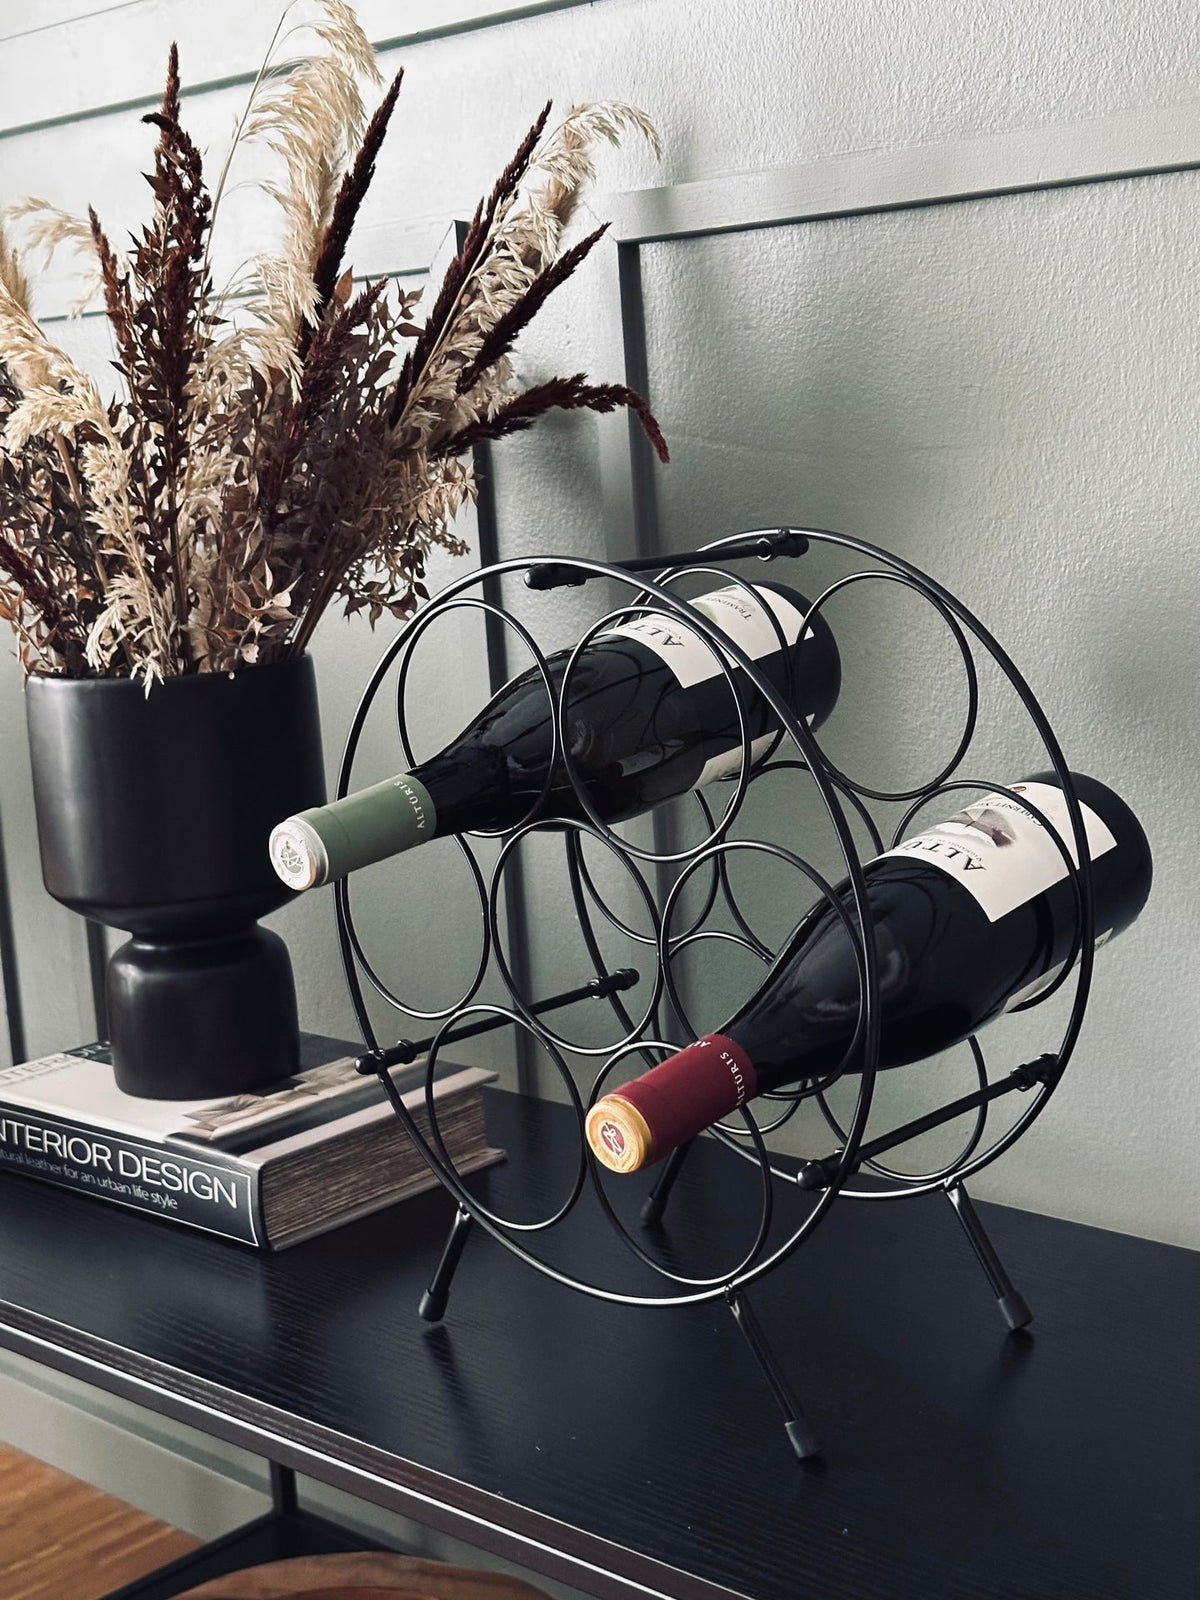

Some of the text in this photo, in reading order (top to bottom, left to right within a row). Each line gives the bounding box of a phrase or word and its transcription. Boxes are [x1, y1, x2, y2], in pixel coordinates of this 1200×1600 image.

[63, 1163, 79, 1179] for
[80, 1171, 96, 1184] an
[97, 1176, 132, 1197] urban
[132, 1183, 149, 1200] life
[150, 1190, 179, 1210] style
[118, 1149, 237, 1209] DESIGN
